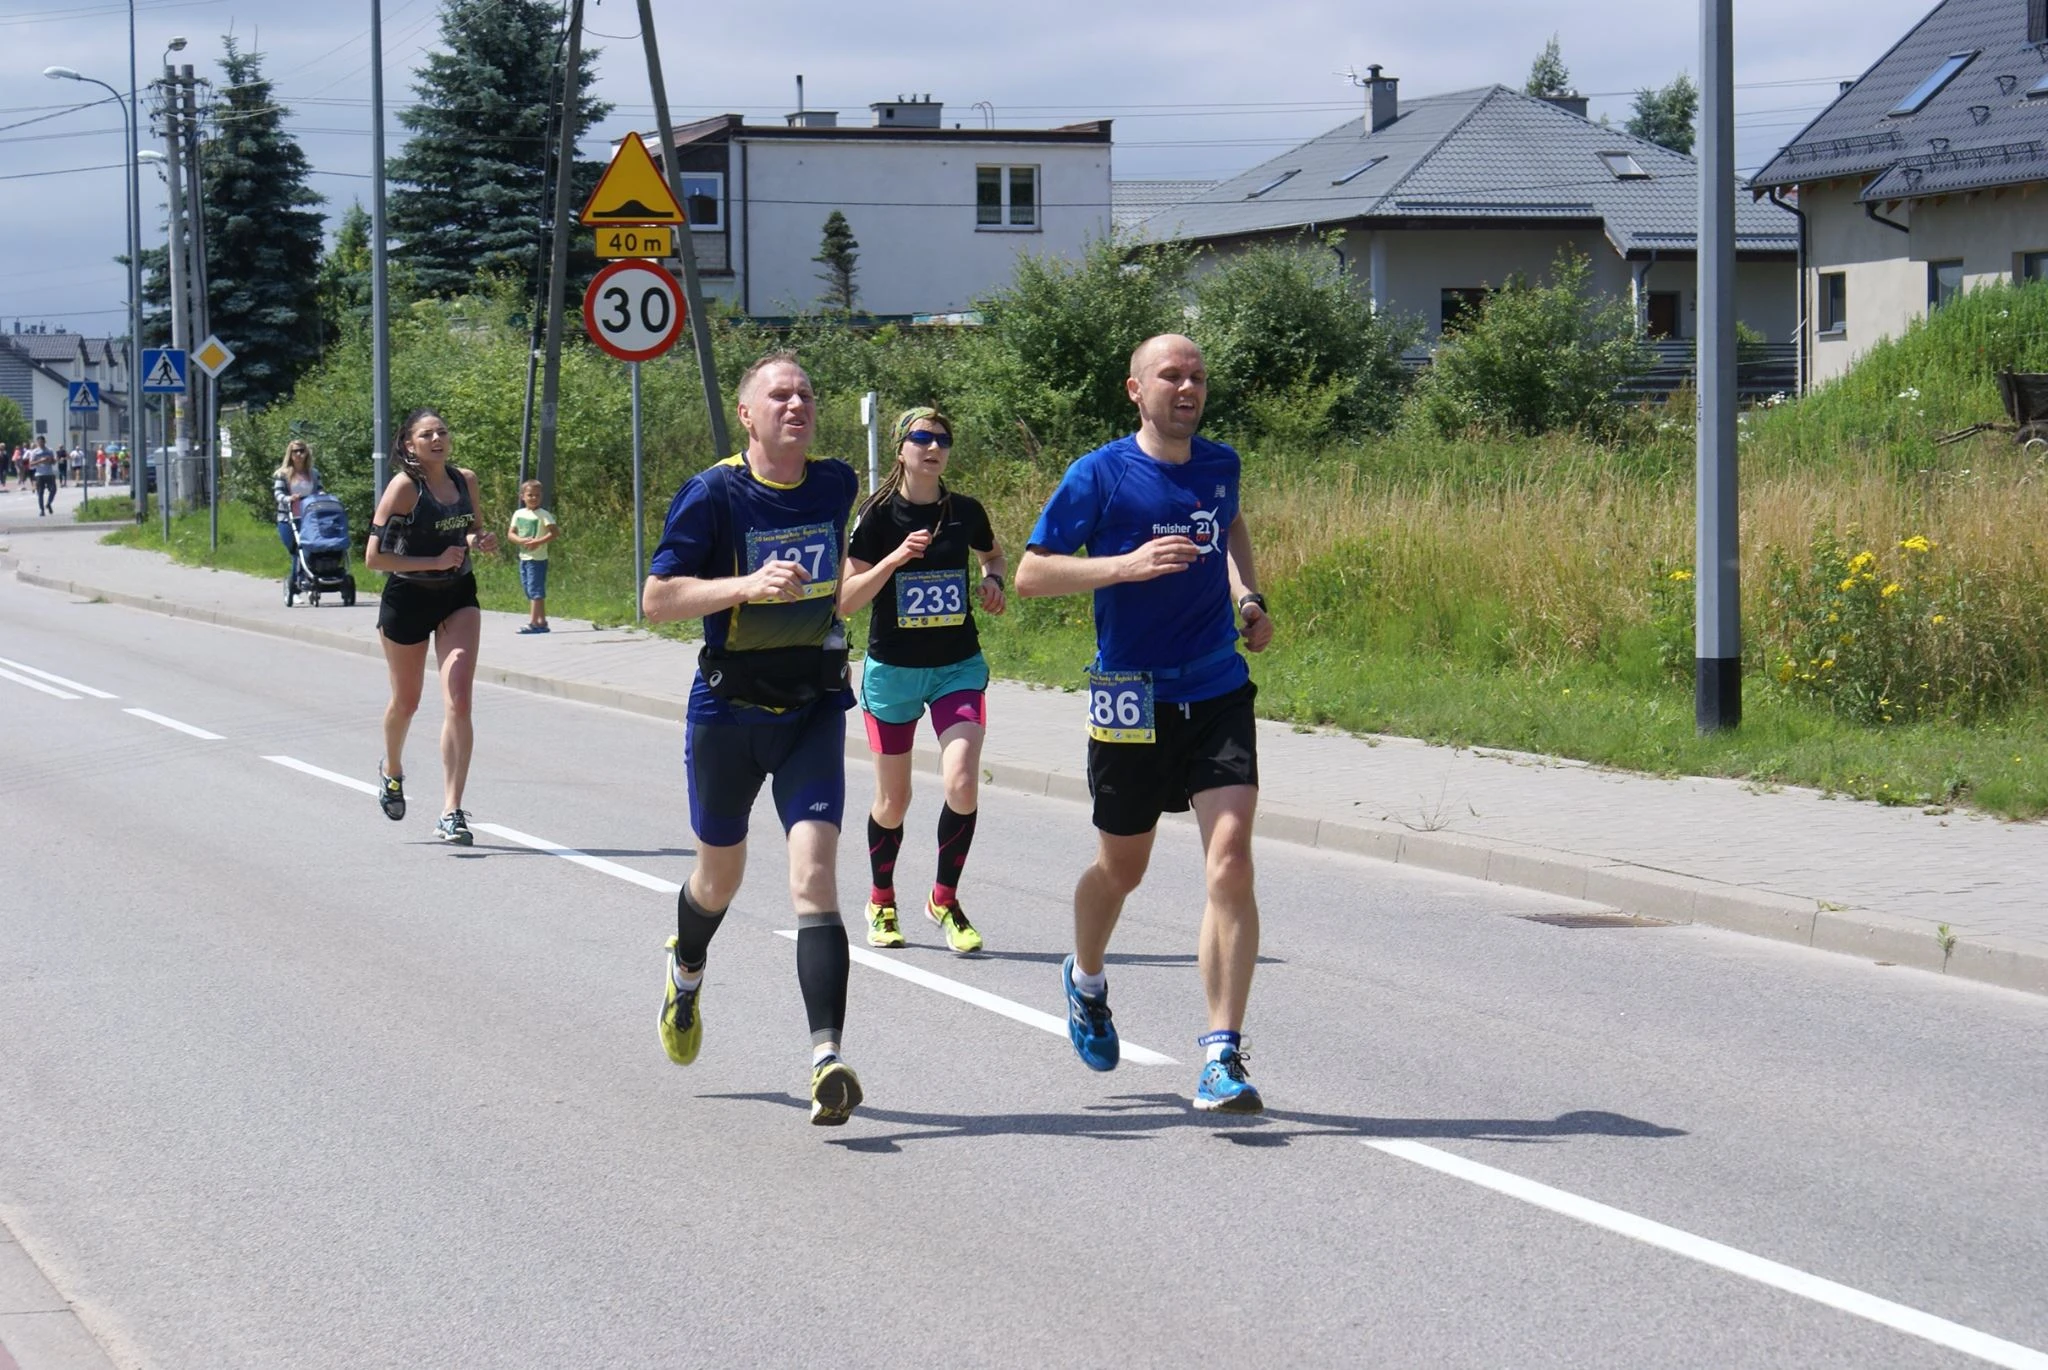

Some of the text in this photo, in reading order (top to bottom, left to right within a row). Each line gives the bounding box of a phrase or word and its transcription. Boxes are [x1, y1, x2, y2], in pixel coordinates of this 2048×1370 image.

[609, 234, 661, 251] 40 m
[602, 286, 670, 333] 30
[1152, 523, 1191, 534] finisher
[1196, 521, 1211, 534] 21
[907, 584, 961, 614] 233
